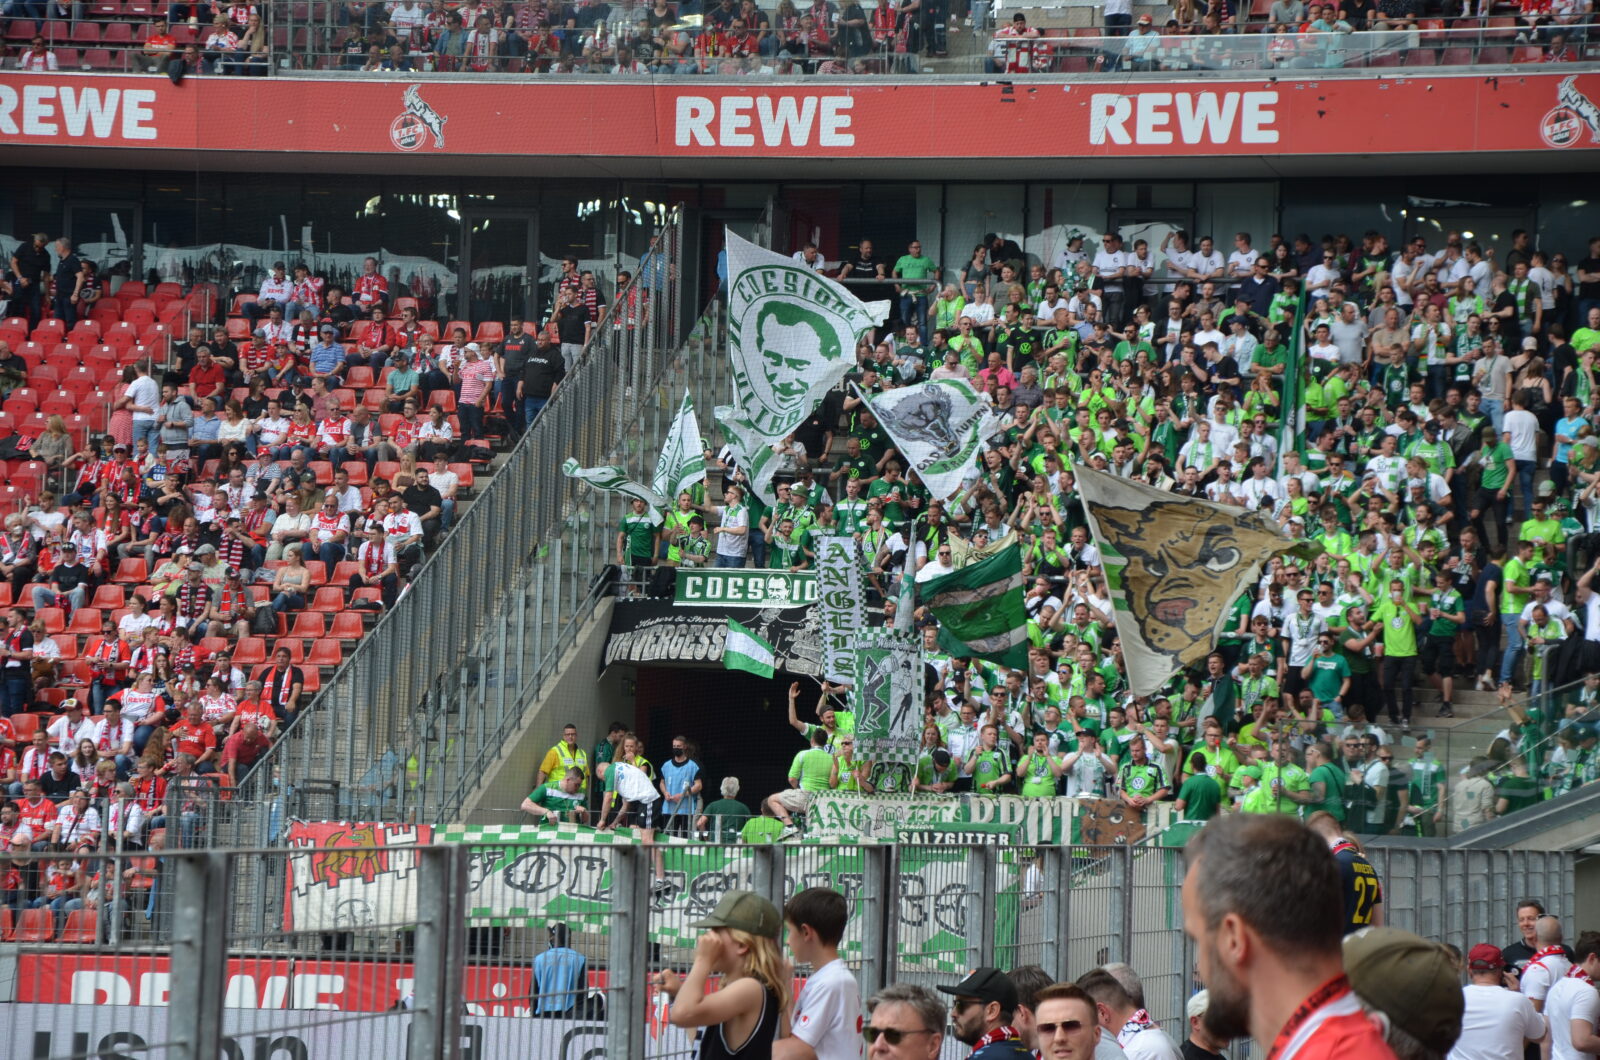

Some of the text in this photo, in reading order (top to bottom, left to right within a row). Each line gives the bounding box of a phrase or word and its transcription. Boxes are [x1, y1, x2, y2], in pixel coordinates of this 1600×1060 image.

[675, 95, 855, 147] REWE
[1089, 91, 1279, 145] REWE
[685, 576, 819, 601] COESIO
[604, 623, 729, 667] UNVERGESS
[897, 831, 1009, 846] SALZGITTER
[1352, 876, 1378, 924] 27
